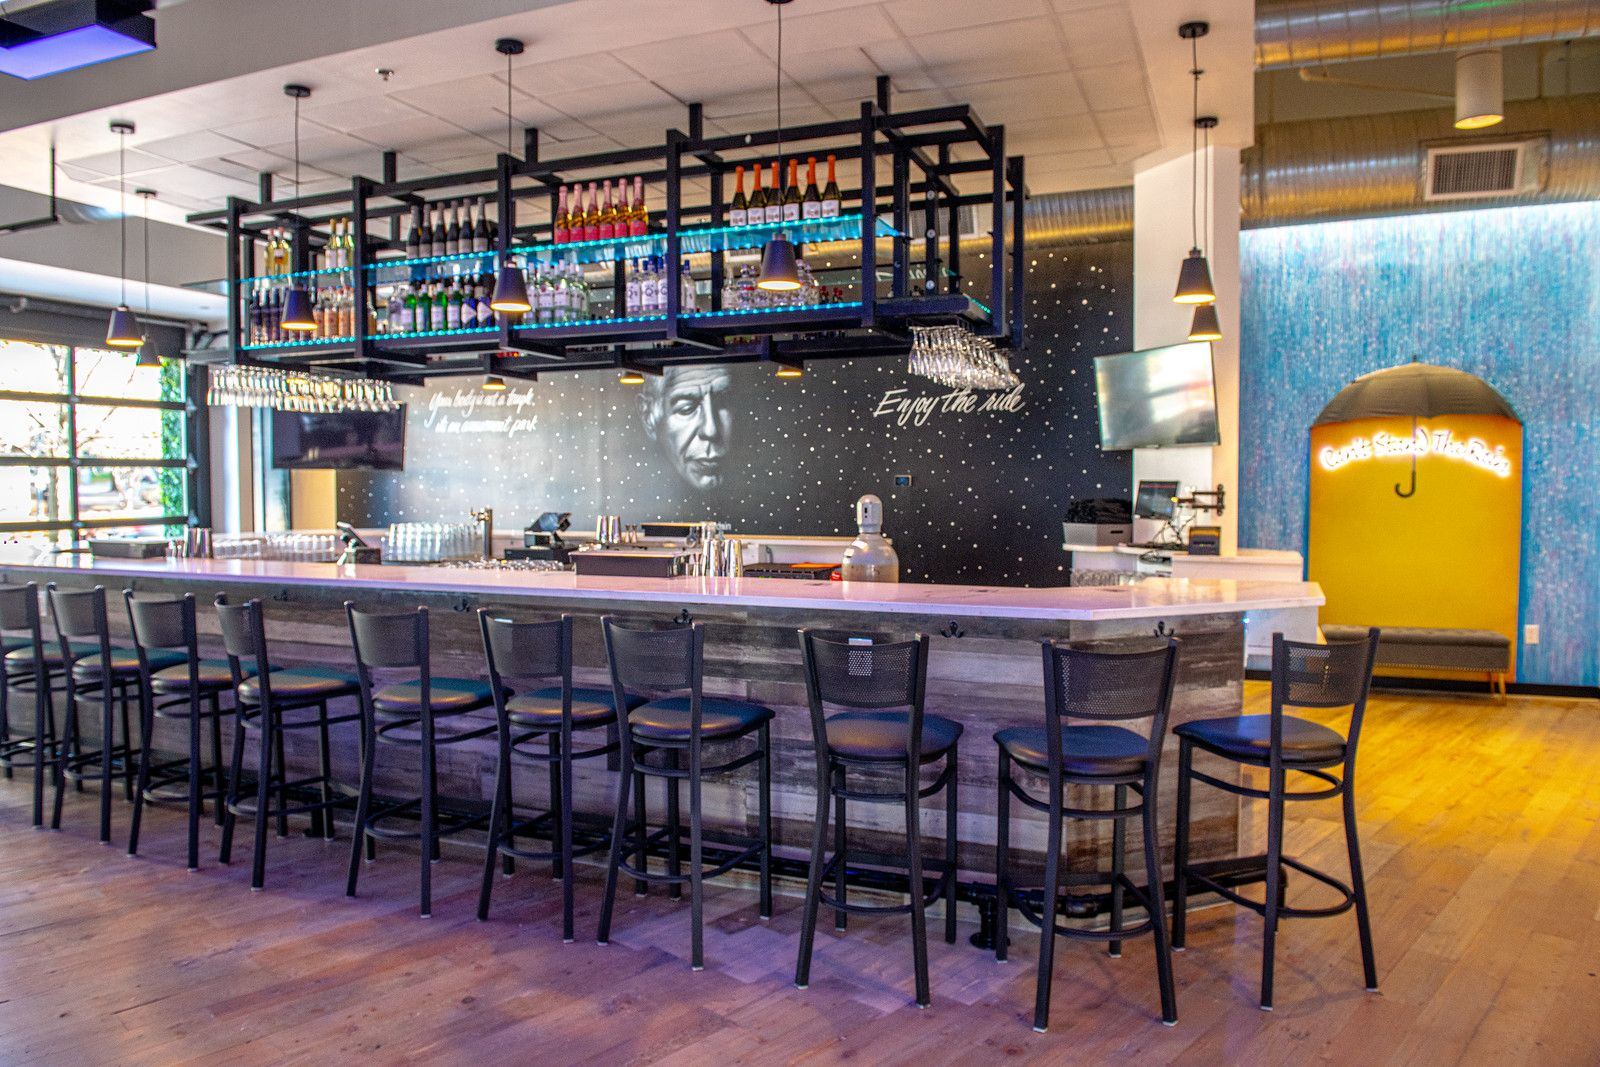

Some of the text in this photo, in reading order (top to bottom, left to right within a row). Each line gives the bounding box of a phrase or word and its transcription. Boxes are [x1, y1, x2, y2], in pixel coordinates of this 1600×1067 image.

[873, 382, 1026, 426] Enjoy the ride
